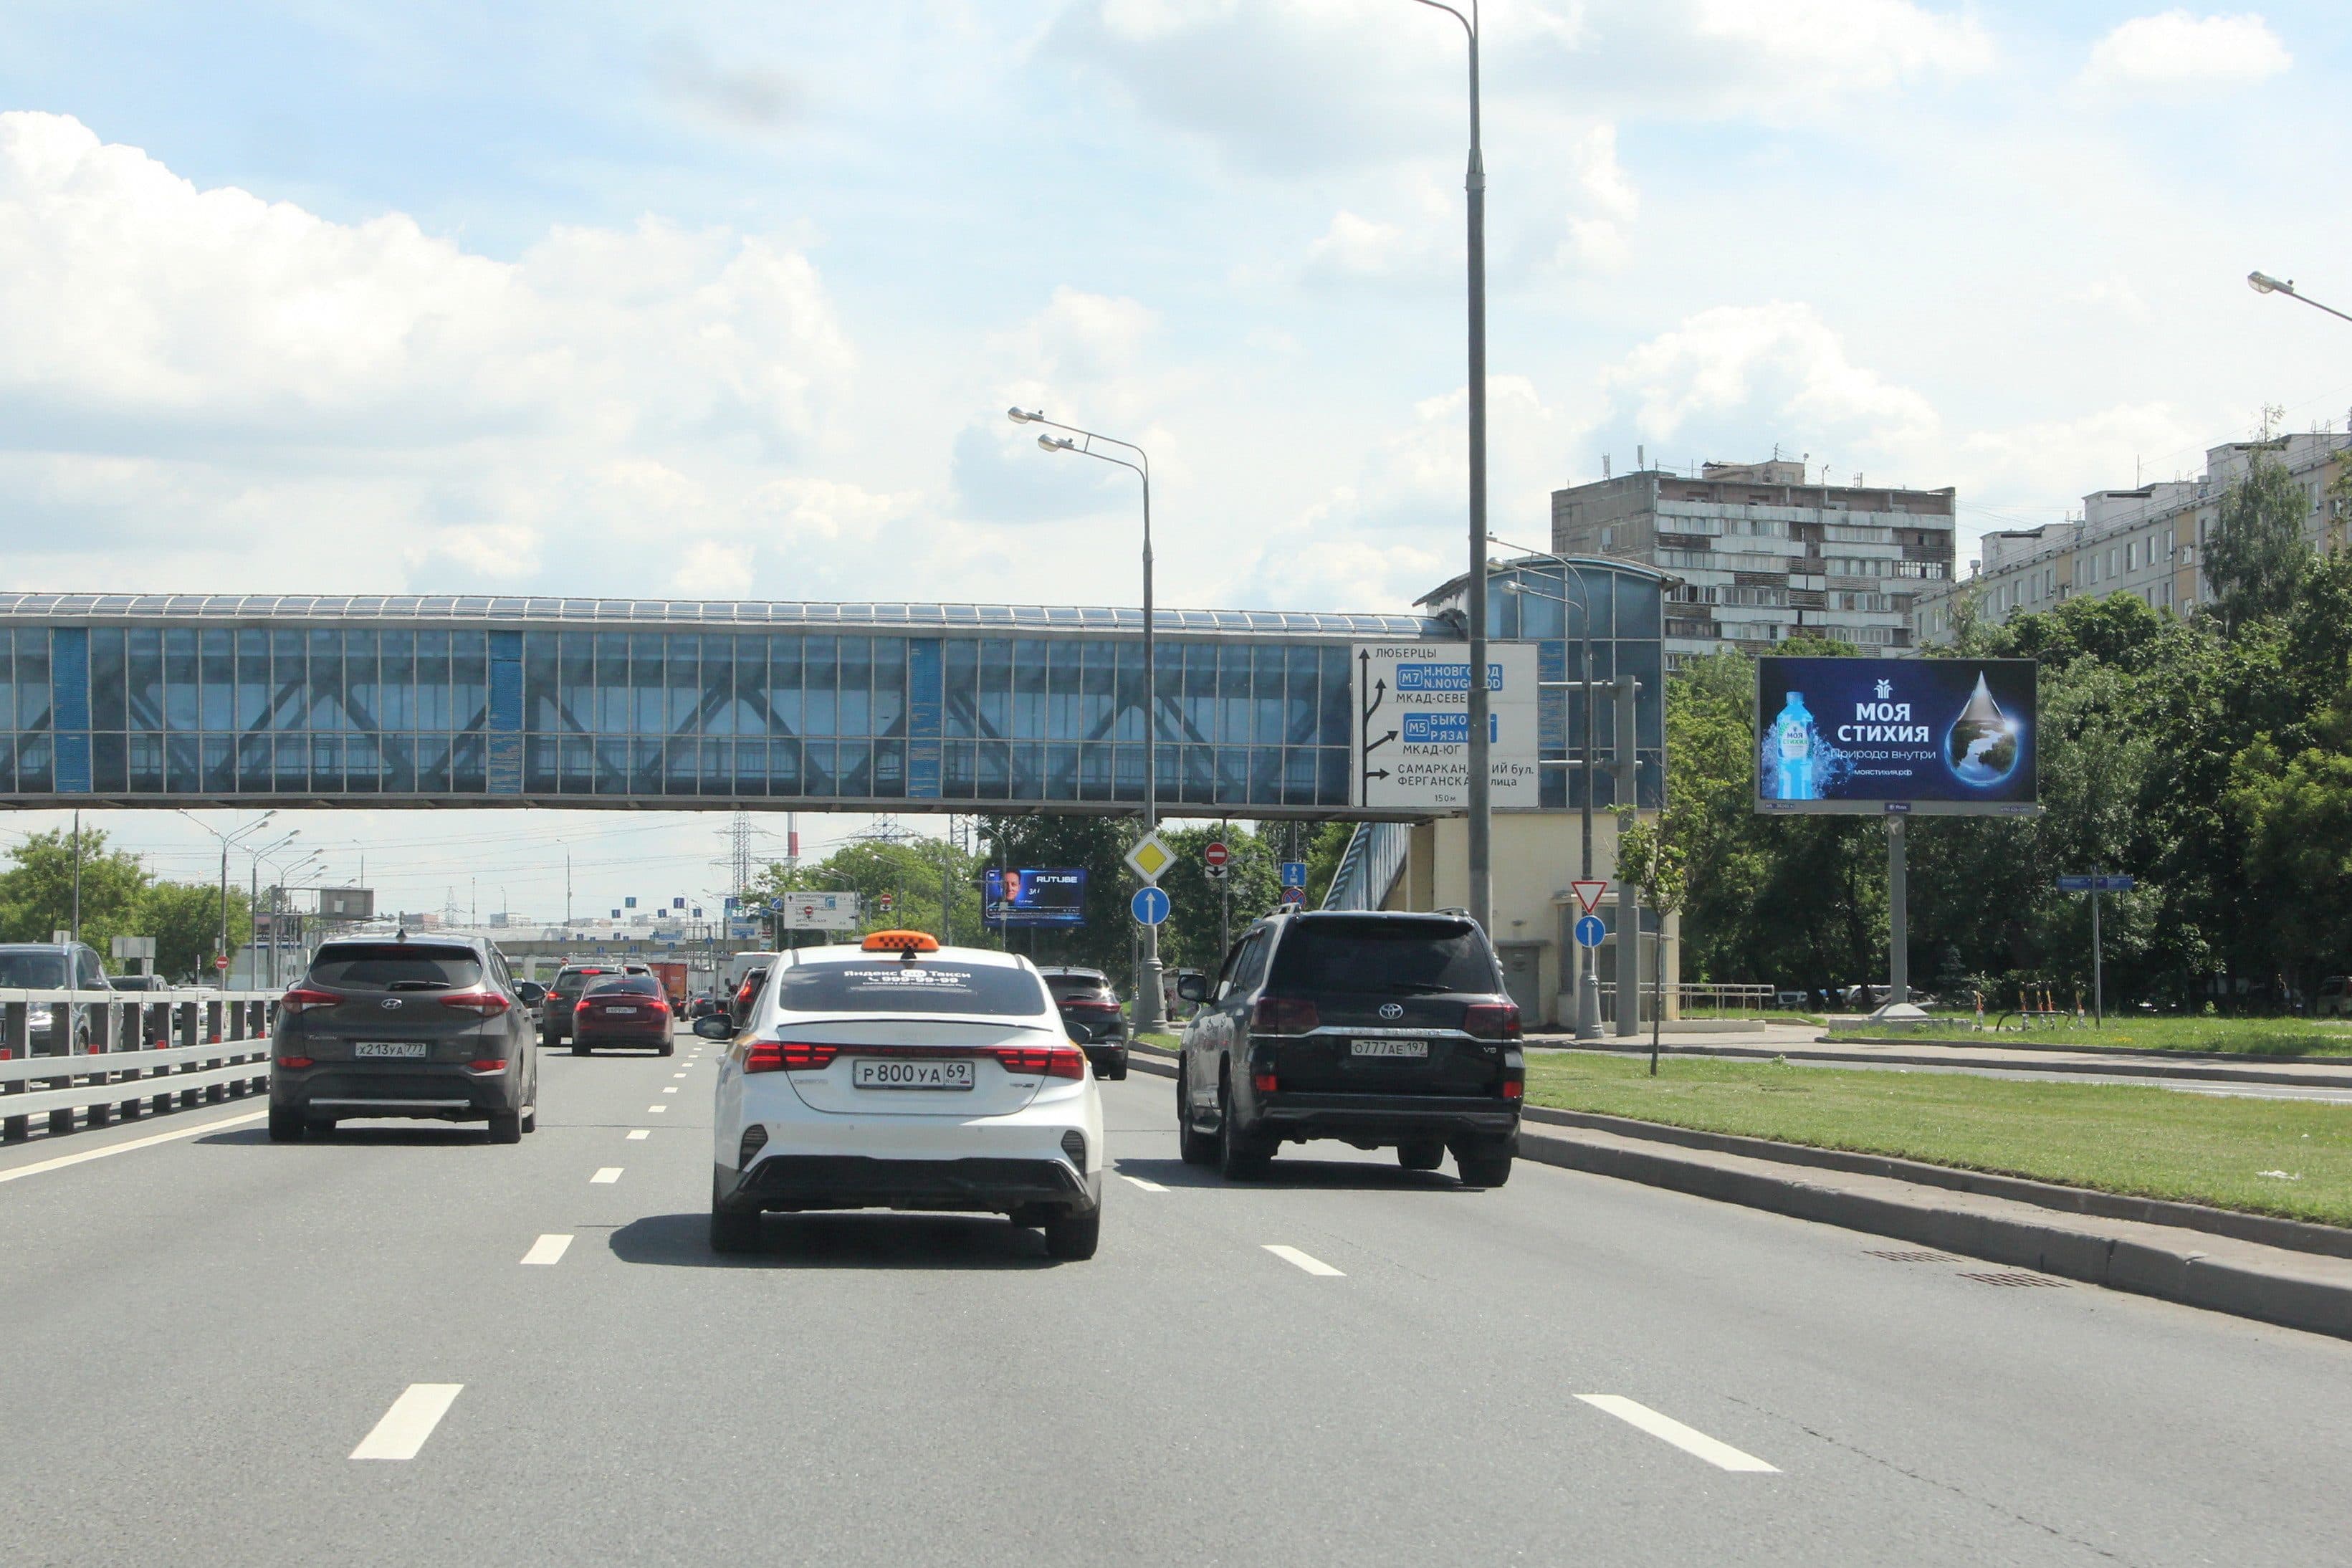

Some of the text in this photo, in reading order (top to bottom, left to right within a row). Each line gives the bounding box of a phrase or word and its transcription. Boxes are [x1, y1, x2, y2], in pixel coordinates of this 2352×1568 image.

[1375, 648, 1437, 659] ЛЮБЕРЦЫ
[1424, 666, 1500, 678] Н.НОВГД
[1423, 678, 1501, 689] N.NOVGOD
[1396, 693, 1466, 704] МКАД-СЕВЕ
[1856, 703, 1911, 722] МОЯ
[1430, 714, 1468, 725] БЫКО
[1430, 730, 1468, 740] РЯЗА
[1837, 725, 1929, 742] СТИХИЯ
[1402, 745, 1461, 756] МКАД-ЮГ
[1830, 748, 1936, 760] Природа внутри
[1511, 764, 1534, 776] бул.
[1397, 776, 1517, 788] ФЕРГАНСКА лица
